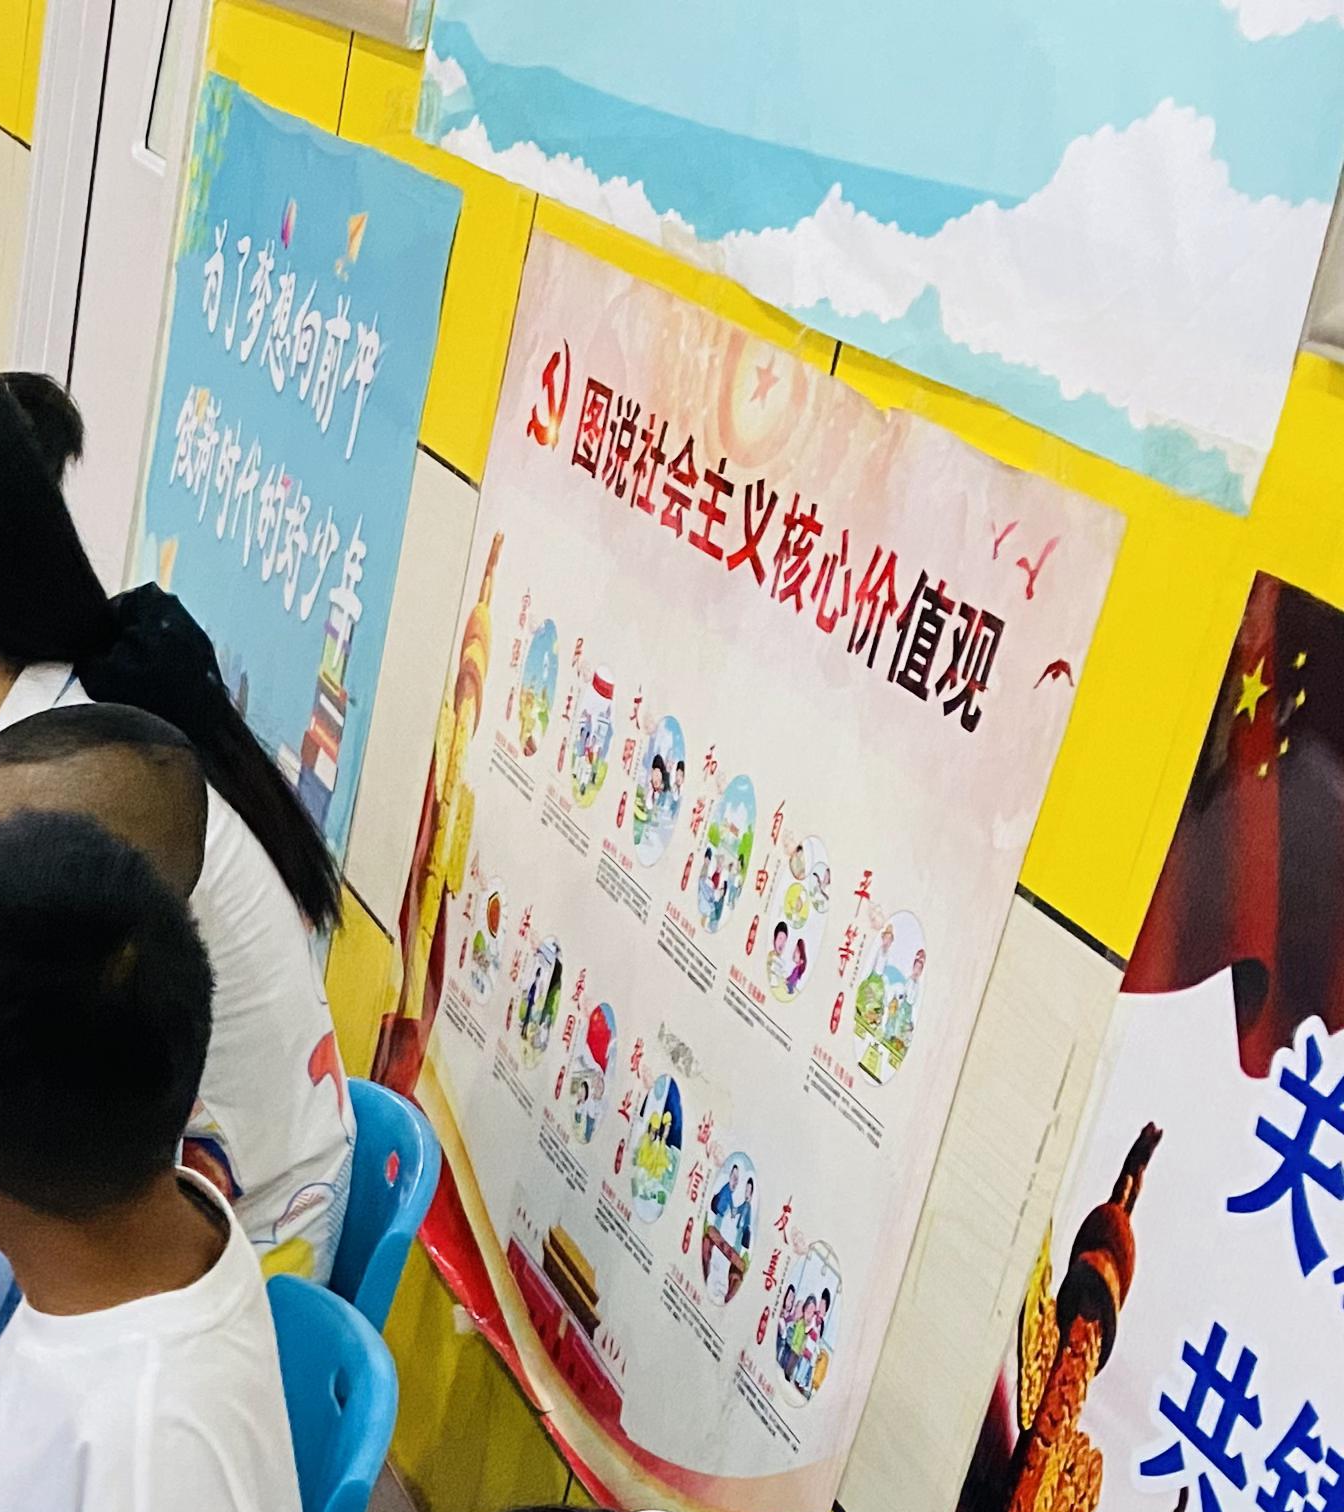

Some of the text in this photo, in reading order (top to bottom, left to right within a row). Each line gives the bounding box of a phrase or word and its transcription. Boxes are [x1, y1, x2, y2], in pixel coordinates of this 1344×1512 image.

[201, 218, 386, 461] 为了梦想向前冲
[169, 383, 368, 670] 做新时代的好少年
[570, 376, 1009, 734] 图说社会主义核心价值观
[755, 799, 786, 898] 自由
[837, 869, 873, 978] 平等
[1227, 1034, 1344, 1310] 关
